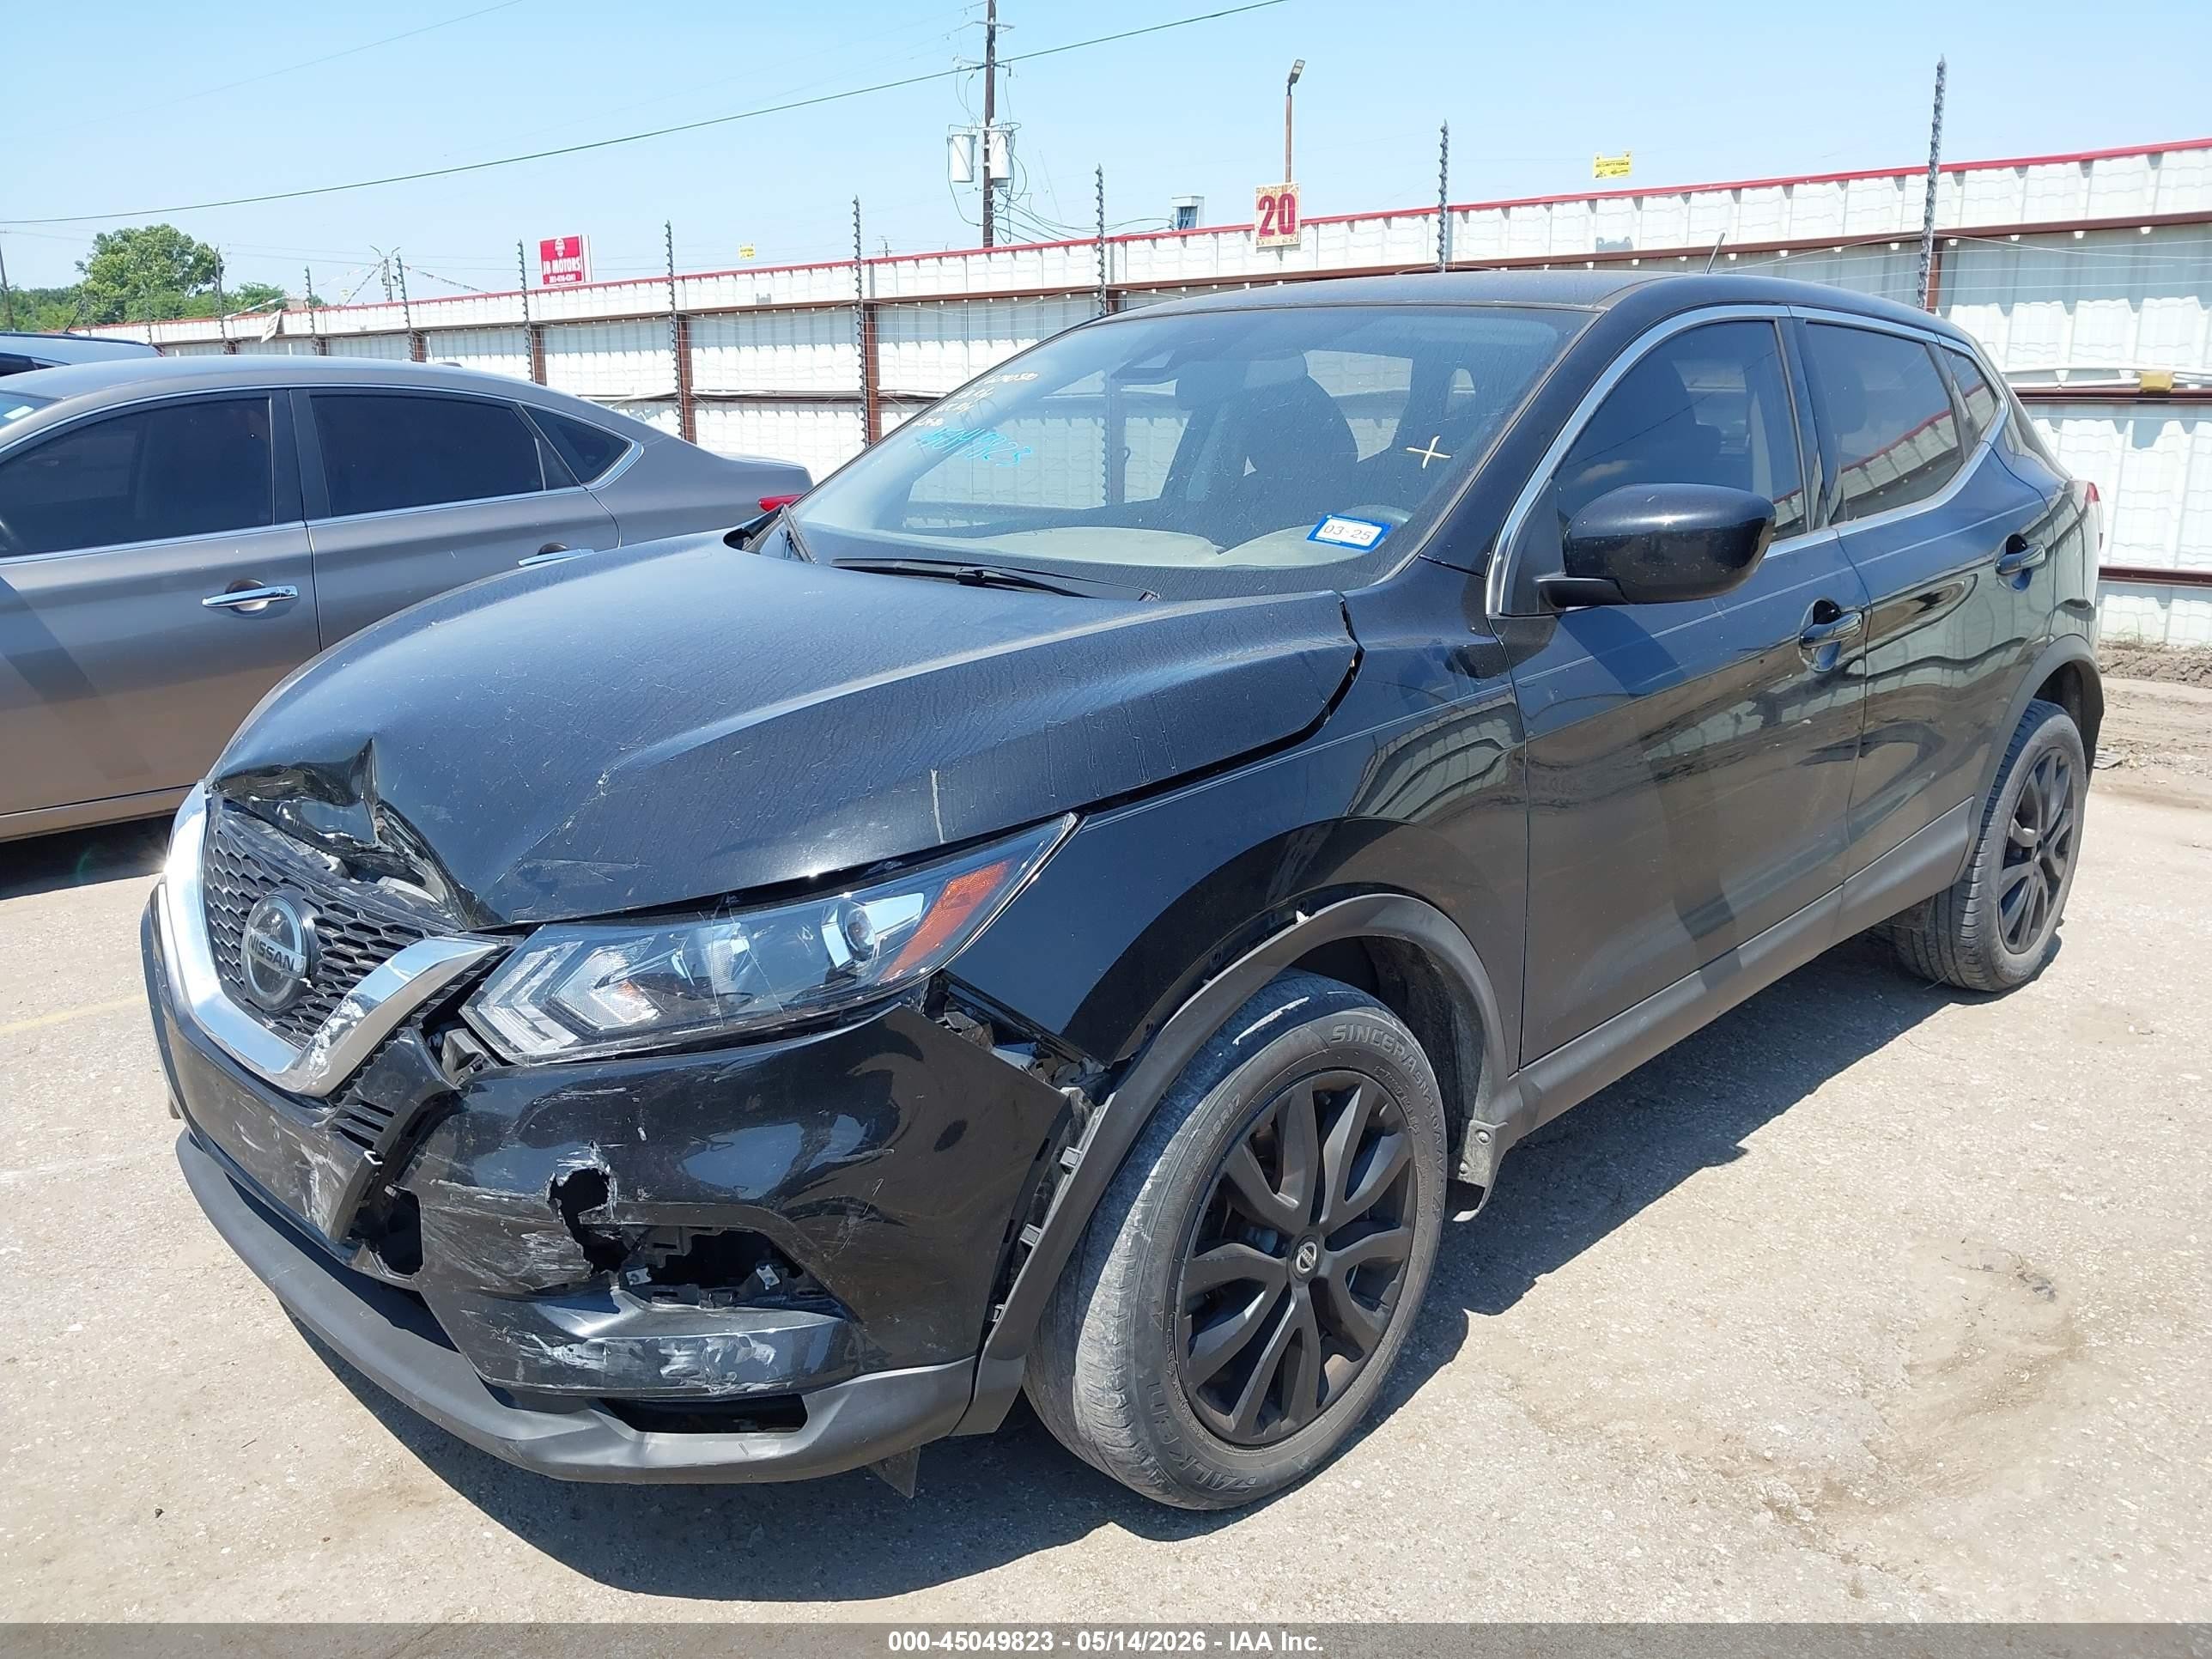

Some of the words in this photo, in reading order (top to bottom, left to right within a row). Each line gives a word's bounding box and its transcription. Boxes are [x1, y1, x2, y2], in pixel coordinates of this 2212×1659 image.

[1258, 193, 1296, 236] 20
[552, 257, 581, 274] MOTORS
[248, 934, 295, 972] NISSAN
[1331, 1023, 1417, 1072] SINCERA
